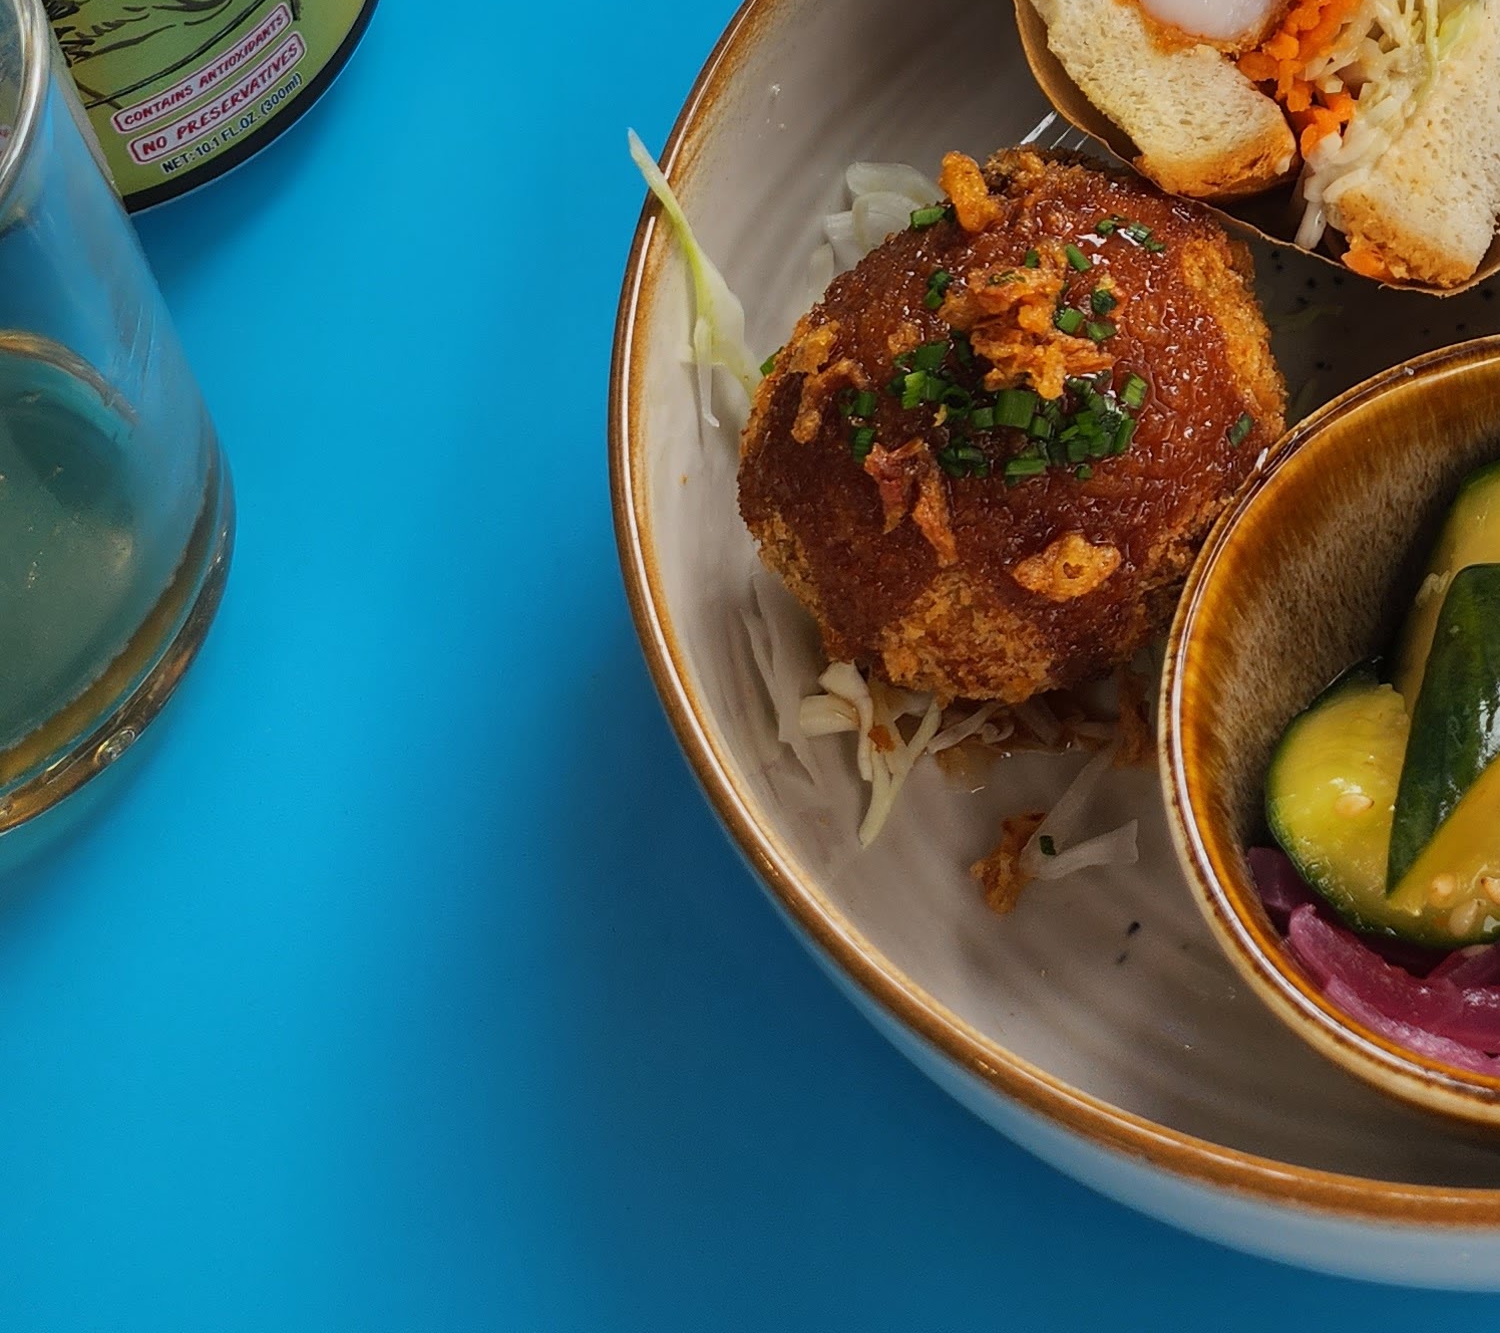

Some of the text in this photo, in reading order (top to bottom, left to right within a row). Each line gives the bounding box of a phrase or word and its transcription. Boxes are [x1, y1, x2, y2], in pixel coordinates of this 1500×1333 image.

[124, 14, 284, 125] CONTAINS ANTIOXIDANTS
[142, 42, 298, 156] NO PRESERVATIVES
[260, 71, 303, 116] (300ml)
